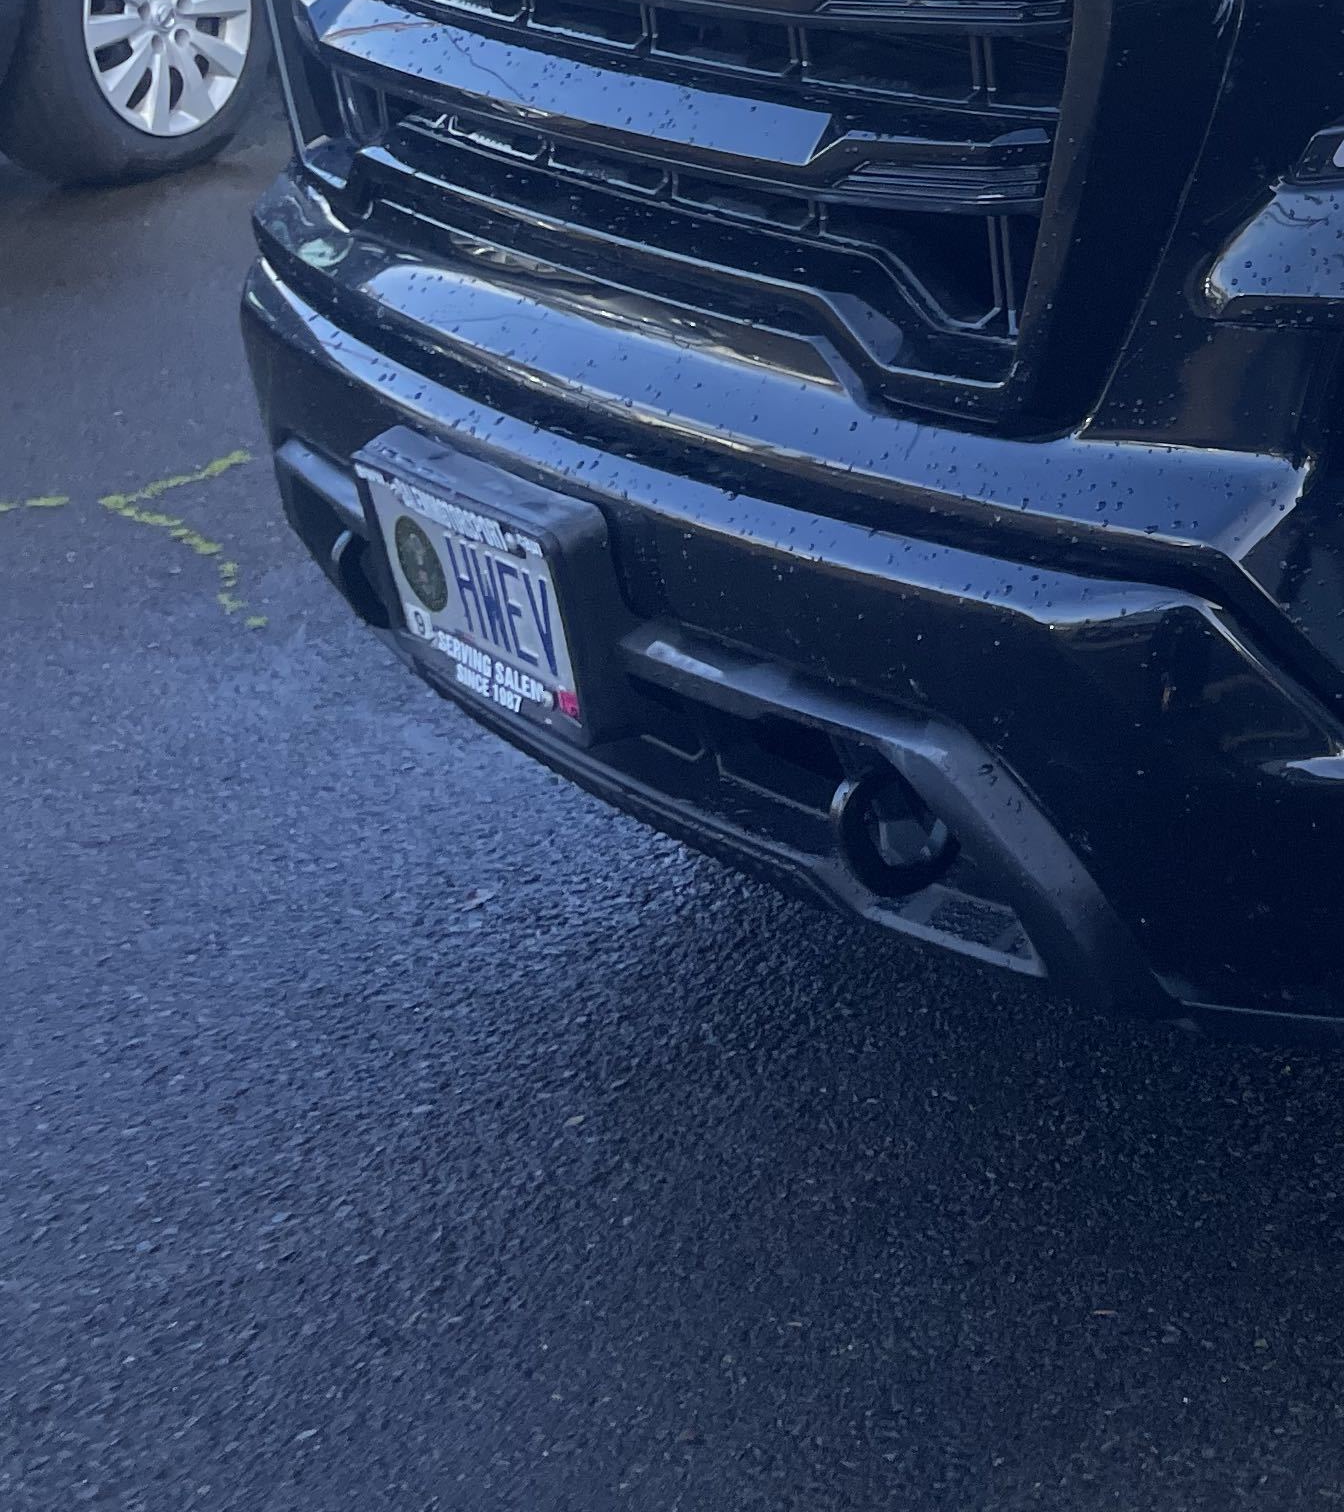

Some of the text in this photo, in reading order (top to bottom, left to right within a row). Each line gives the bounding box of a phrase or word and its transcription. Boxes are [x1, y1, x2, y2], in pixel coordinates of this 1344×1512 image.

[437, 631, 545, 703] SERVING SALEM
[456, 663, 490, 698] SINCE
